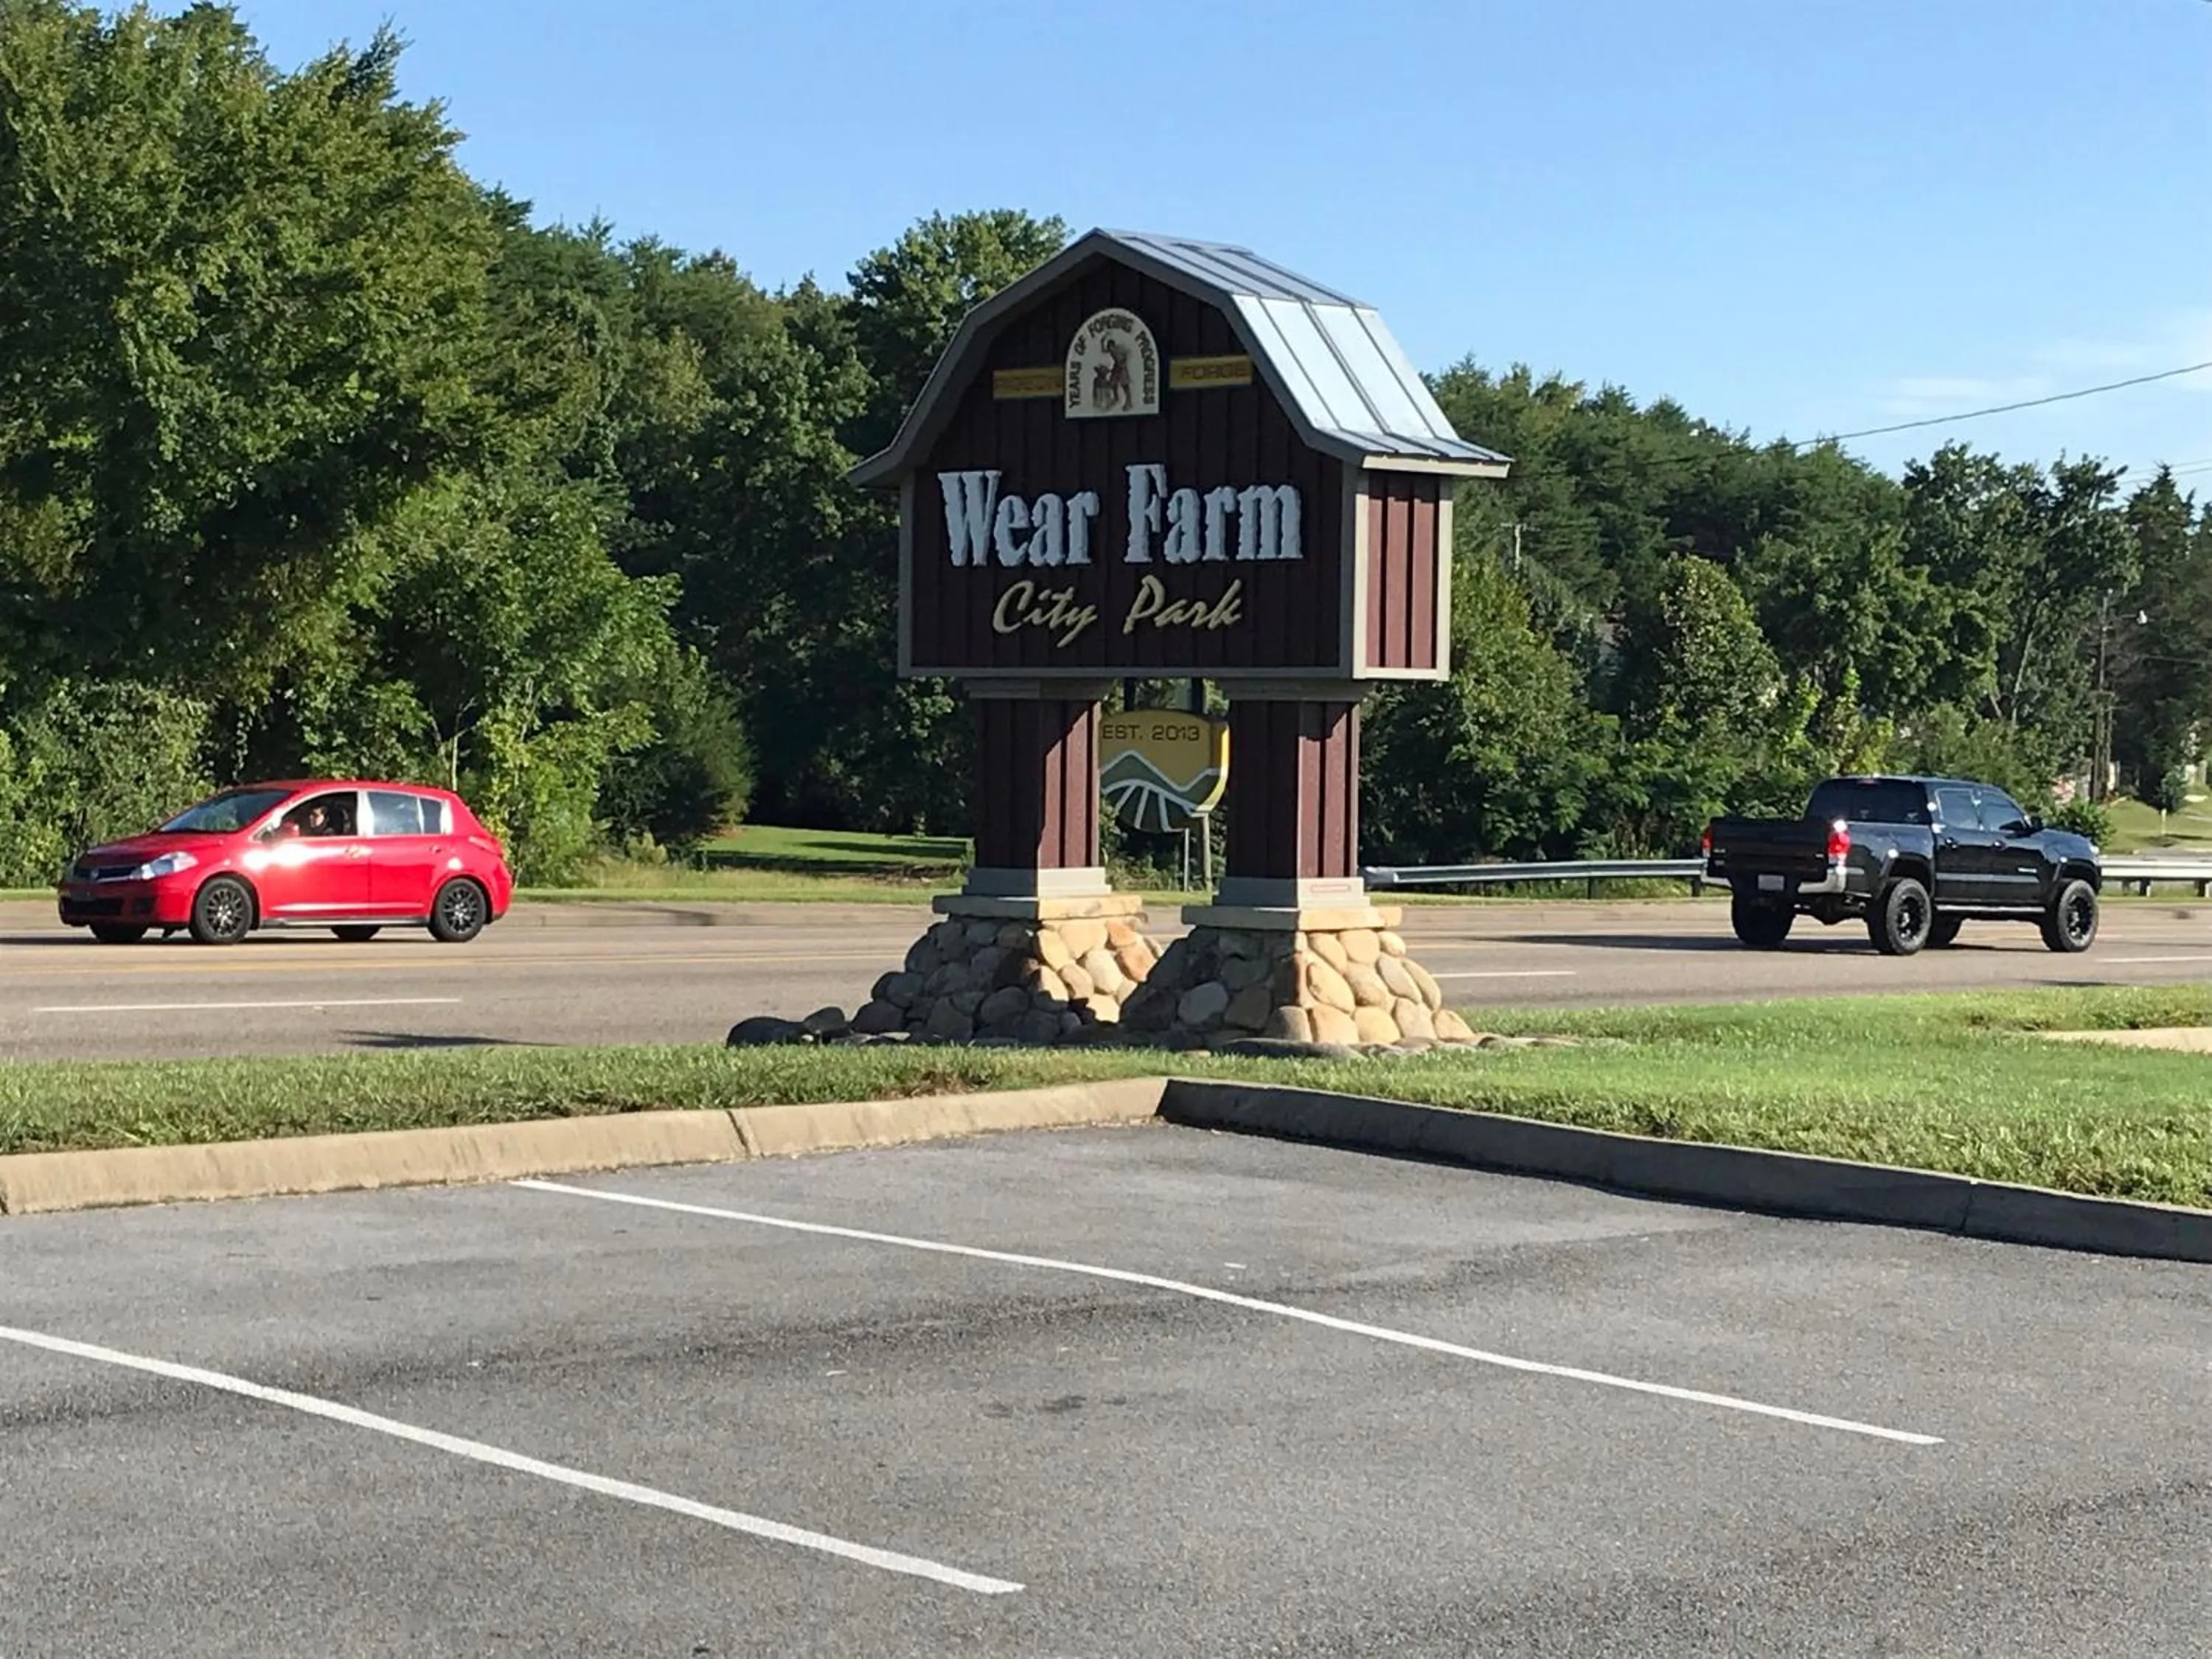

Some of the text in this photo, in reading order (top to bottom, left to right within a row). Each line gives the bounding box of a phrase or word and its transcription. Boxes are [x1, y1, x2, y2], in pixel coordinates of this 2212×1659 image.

[1074, 335, 1086, 356] OF
[1087, 313, 1134, 338] FORGING
[1068, 361, 1082, 408] YEARS
[1135, 330, 1155, 404] PROGRESS
[937, 463, 1304, 567] Wear Farm
[992, 574, 1242, 648] City Park
[1102, 725, 1200, 741] EST. 2013
